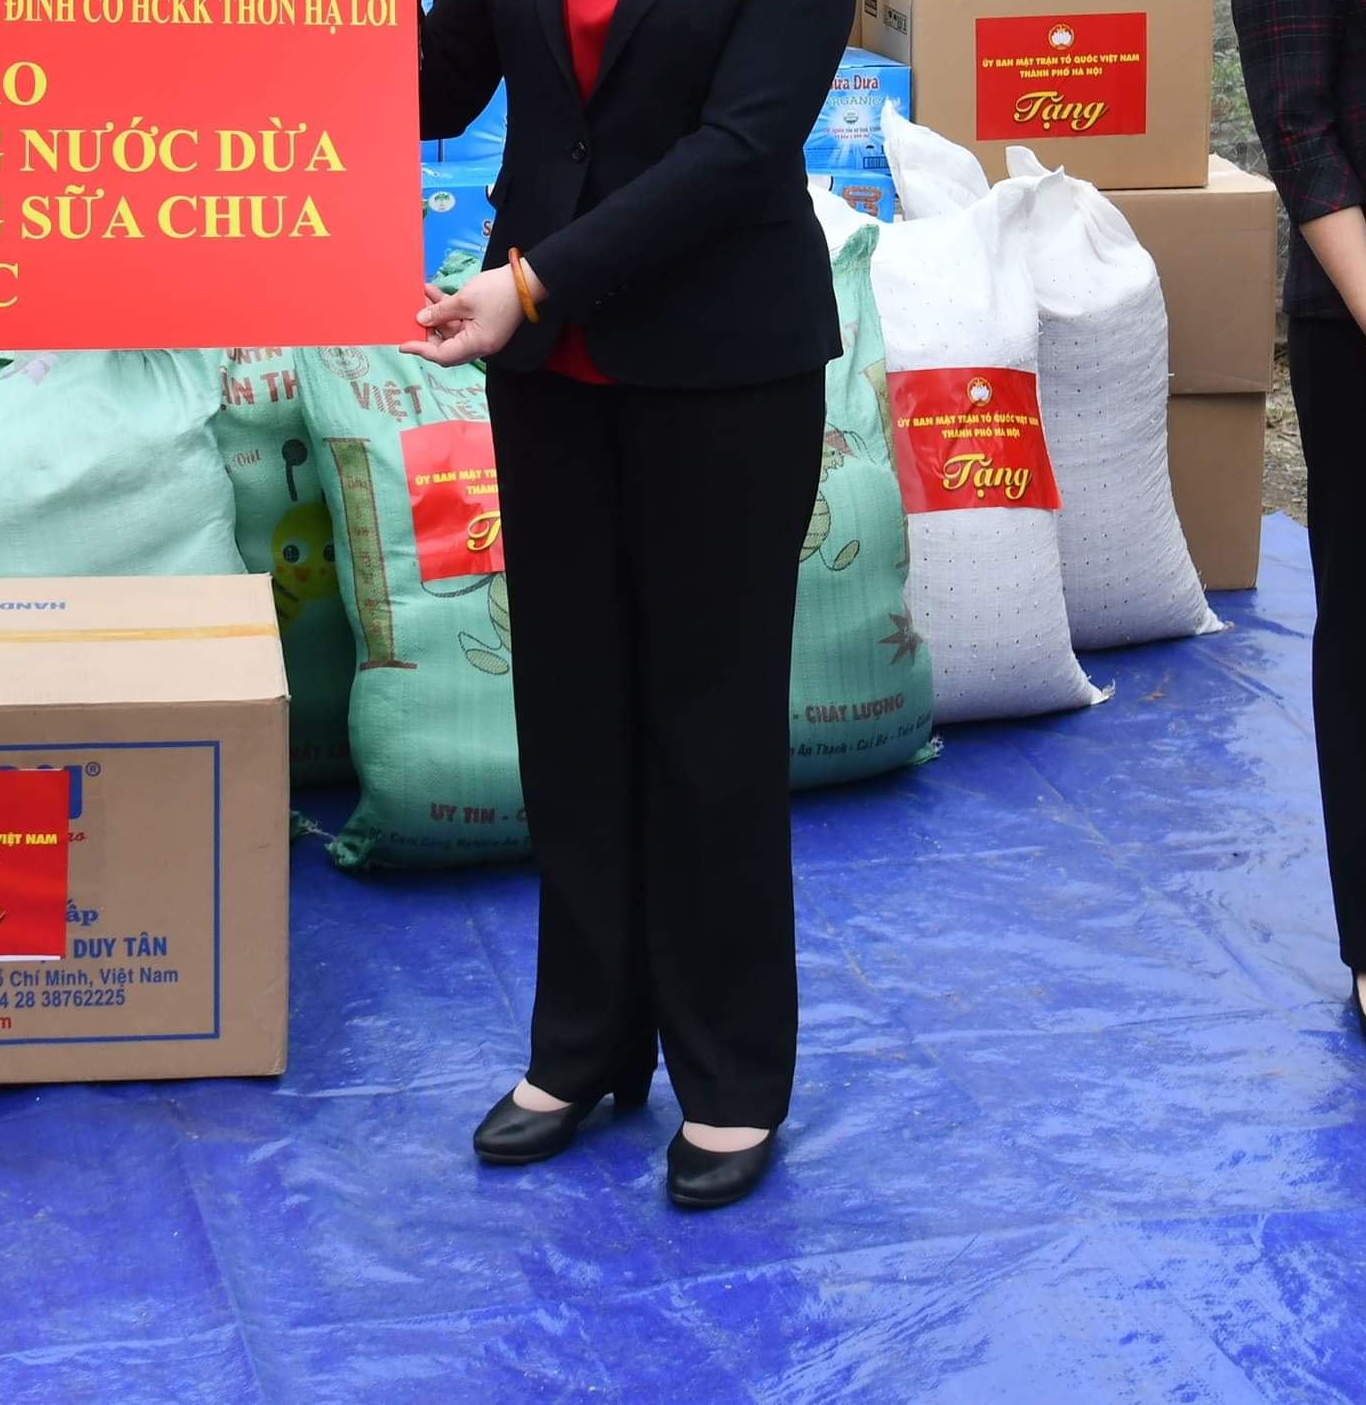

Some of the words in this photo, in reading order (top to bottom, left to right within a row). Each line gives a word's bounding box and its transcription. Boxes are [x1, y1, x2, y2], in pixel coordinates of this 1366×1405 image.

[1013, 90, 1105, 131] Tặng
[20, 116, 198, 172] NƯỚC
[215, 117, 347, 172] DỪA
[22, 185, 145, 239] SỮA
[158, 195, 331, 239] CHUA
[350, 379, 422, 422] VIỆT
[943, 453, 1029, 500] Tặng
[25, 833, 58, 845] NAM
[73, 938, 116, 959] DUY
[123, 931, 168, 957] TÂN
[9, 969, 40, 988] Chí
[45, 969, 94, 989] Minh,
[99, 967, 134, 990] Việt
[139, 967, 178, 984] Nam
[15, 991, 36, 1008] 28
[41, 989, 125, 1007] 38762225
